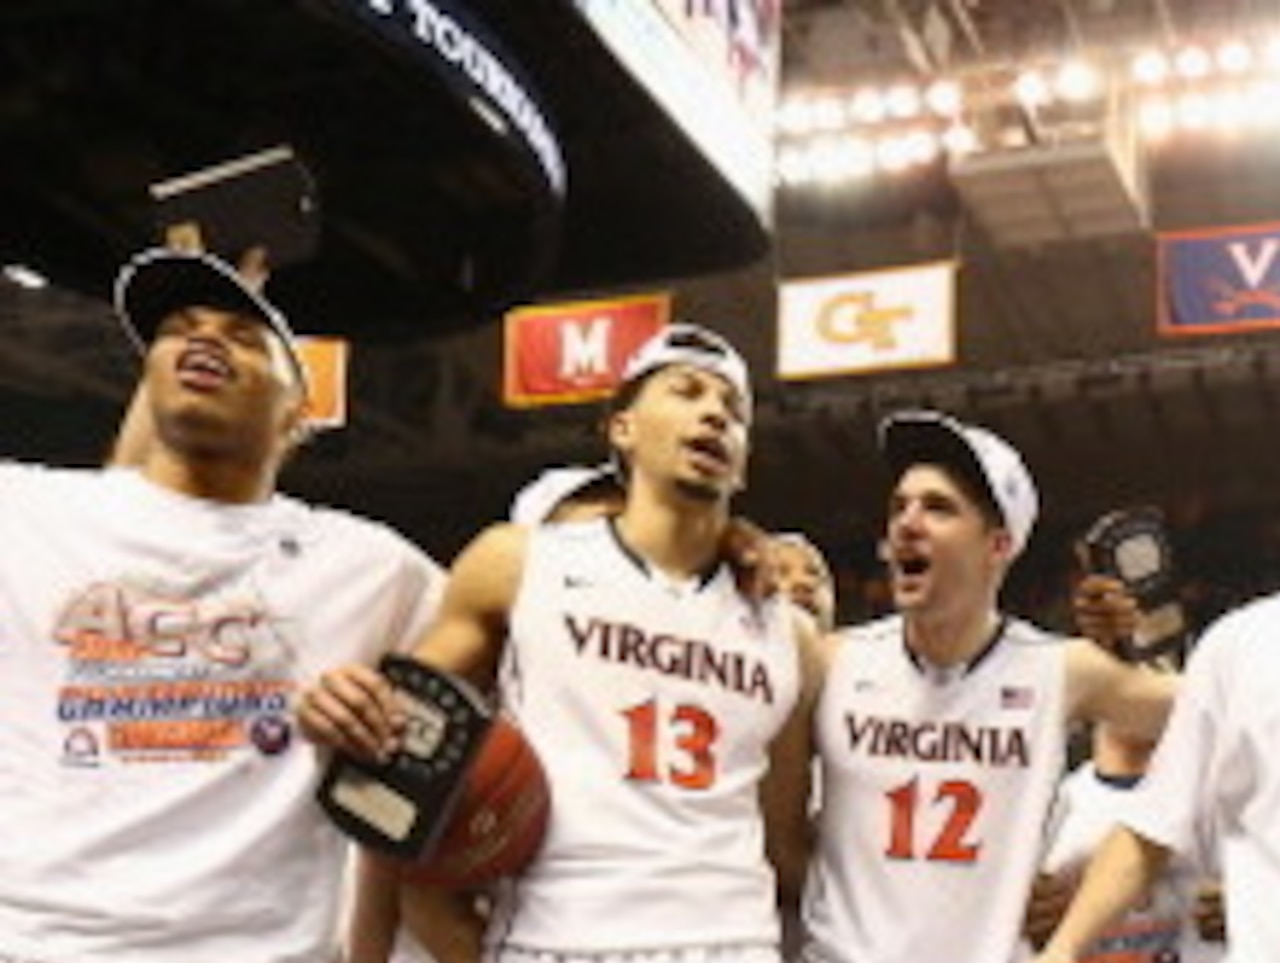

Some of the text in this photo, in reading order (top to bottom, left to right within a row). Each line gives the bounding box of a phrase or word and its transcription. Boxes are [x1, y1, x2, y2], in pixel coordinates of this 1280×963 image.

[559, 317, 613, 379] M
[563, 613, 775, 704] VIRGINIA
[618, 695, 719, 789] 13
[844, 712, 1030, 768] VIRGINIA
[883, 774, 982, 863] 12
